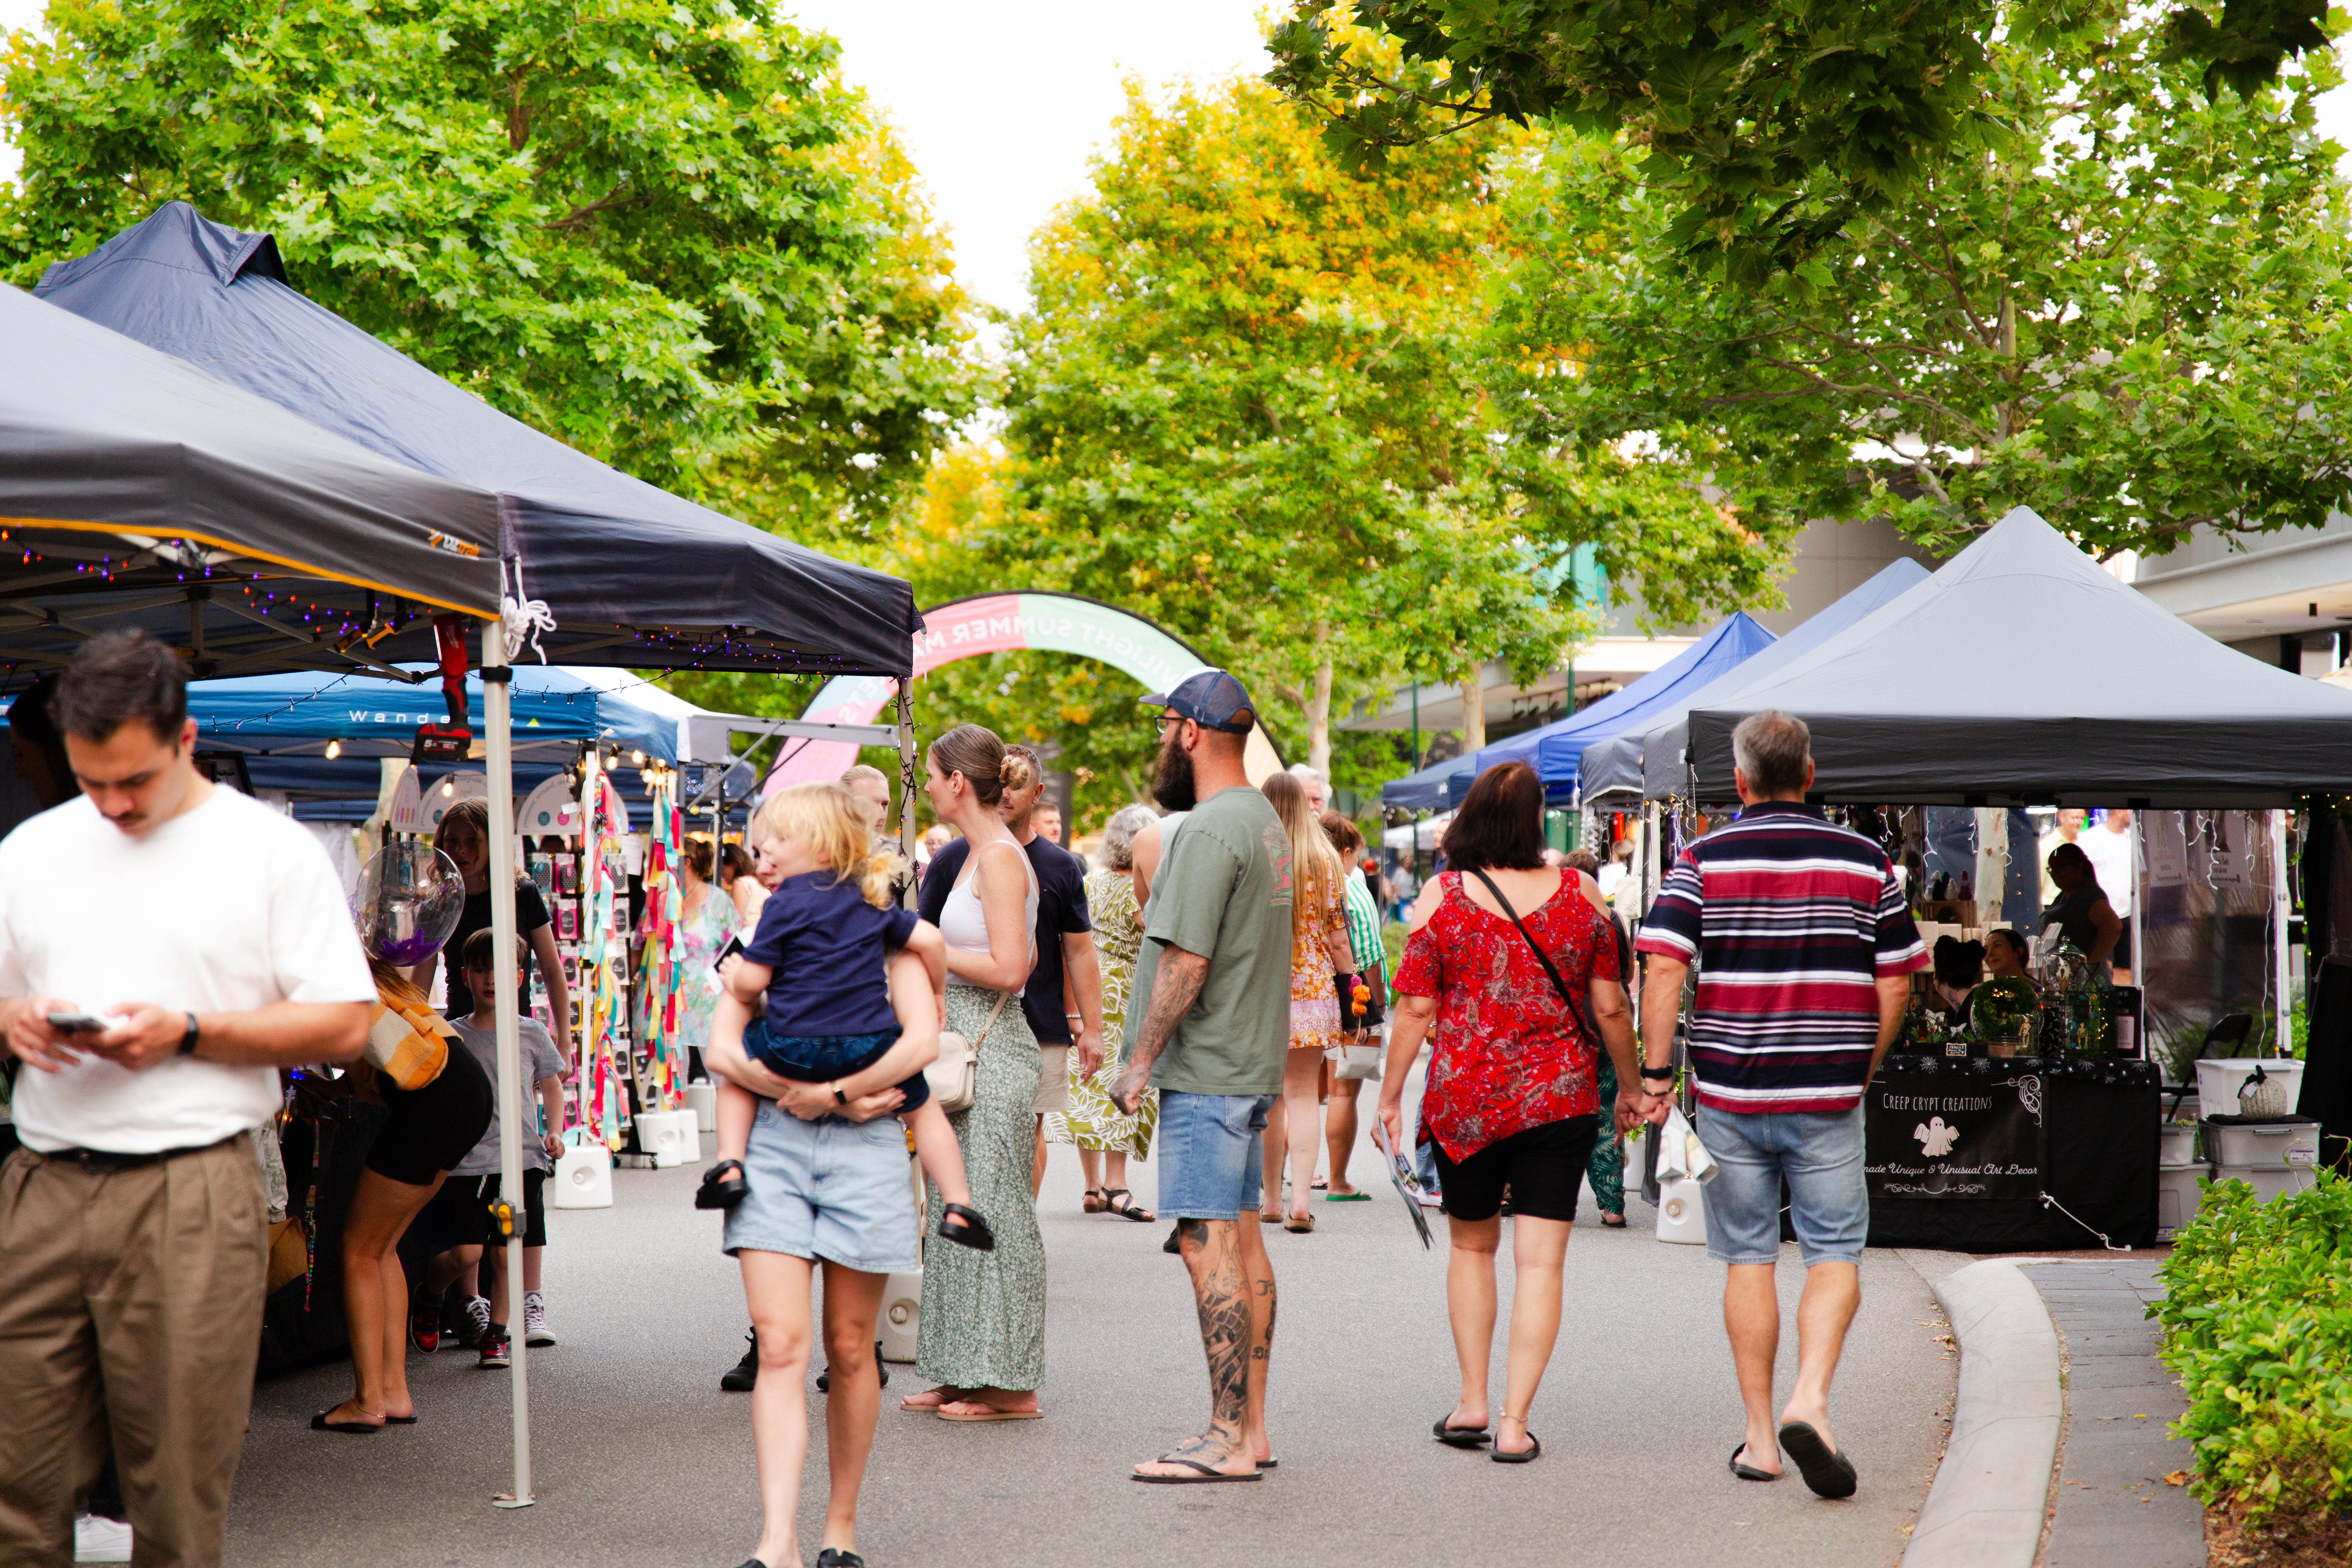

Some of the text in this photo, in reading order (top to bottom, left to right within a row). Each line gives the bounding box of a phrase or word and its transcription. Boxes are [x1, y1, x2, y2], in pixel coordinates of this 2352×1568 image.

[1889, 1162, 1925, 1177] Unique
[1928, 1165, 1936, 1174] &
[1938, 1162, 1981, 1174] Unusual
[1984, 1163, 2002, 1174] Art
[2005, 1164, 2038, 1175] Decor
